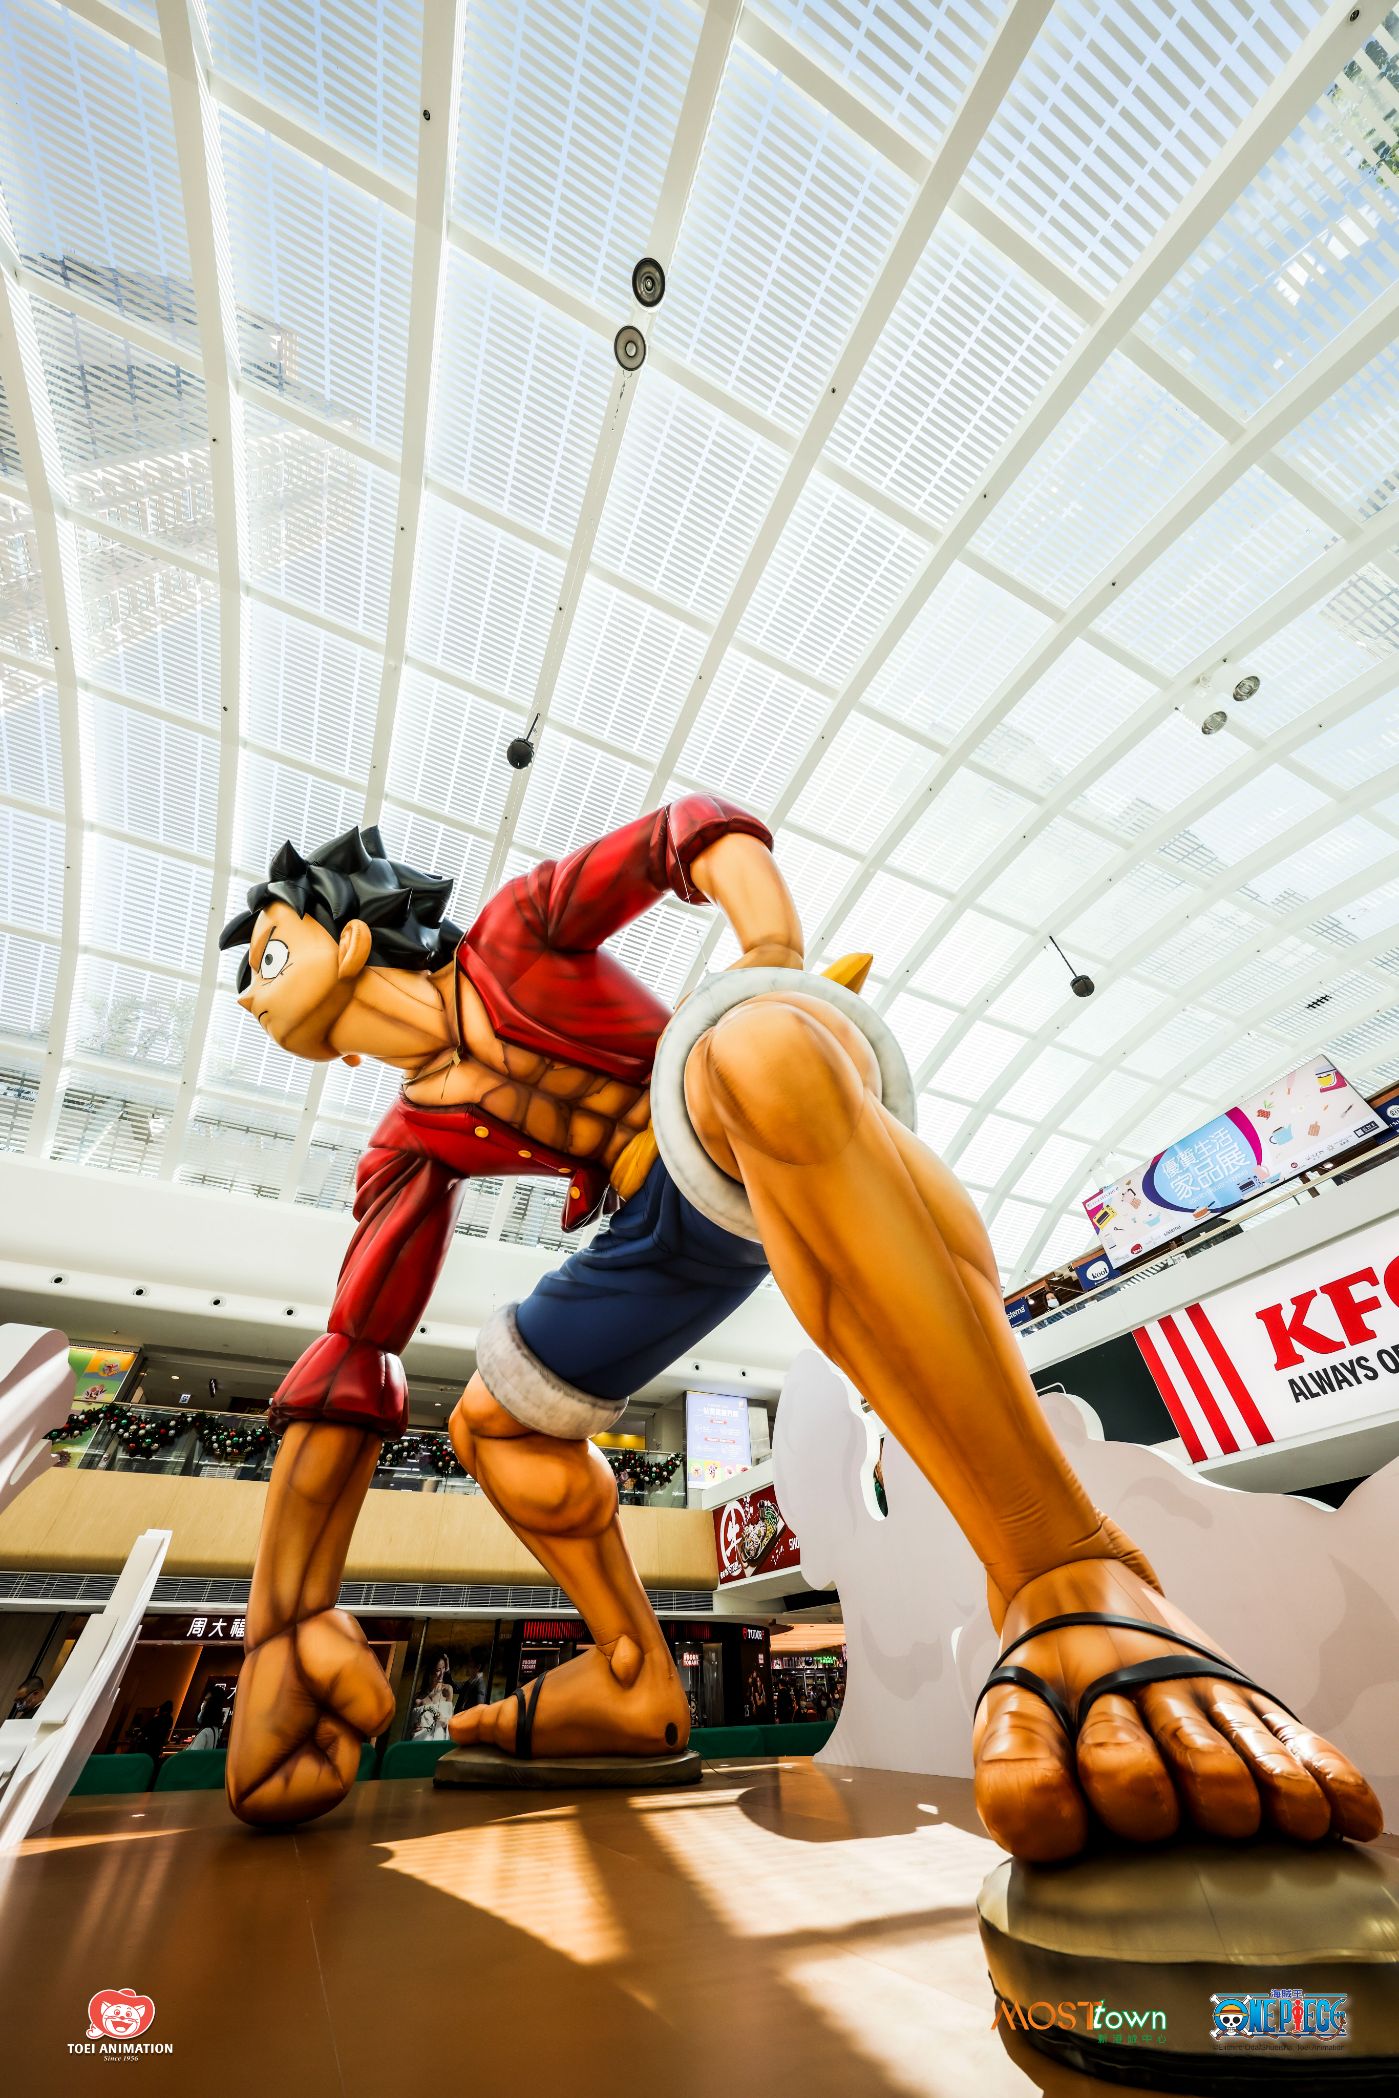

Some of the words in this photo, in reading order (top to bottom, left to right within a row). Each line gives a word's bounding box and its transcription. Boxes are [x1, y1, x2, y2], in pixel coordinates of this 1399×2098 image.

[1162, 1127, 1234, 1179] 優質生活
[1170, 1142, 1250, 1201] 家品展
[1091, 1267, 1109, 1280] kool
[1288, 1356, 1379, 1403] ALWAYS
[186, 1617, 245, 1637] 周大福
[747, 1629, 763, 1640] TUDOR
